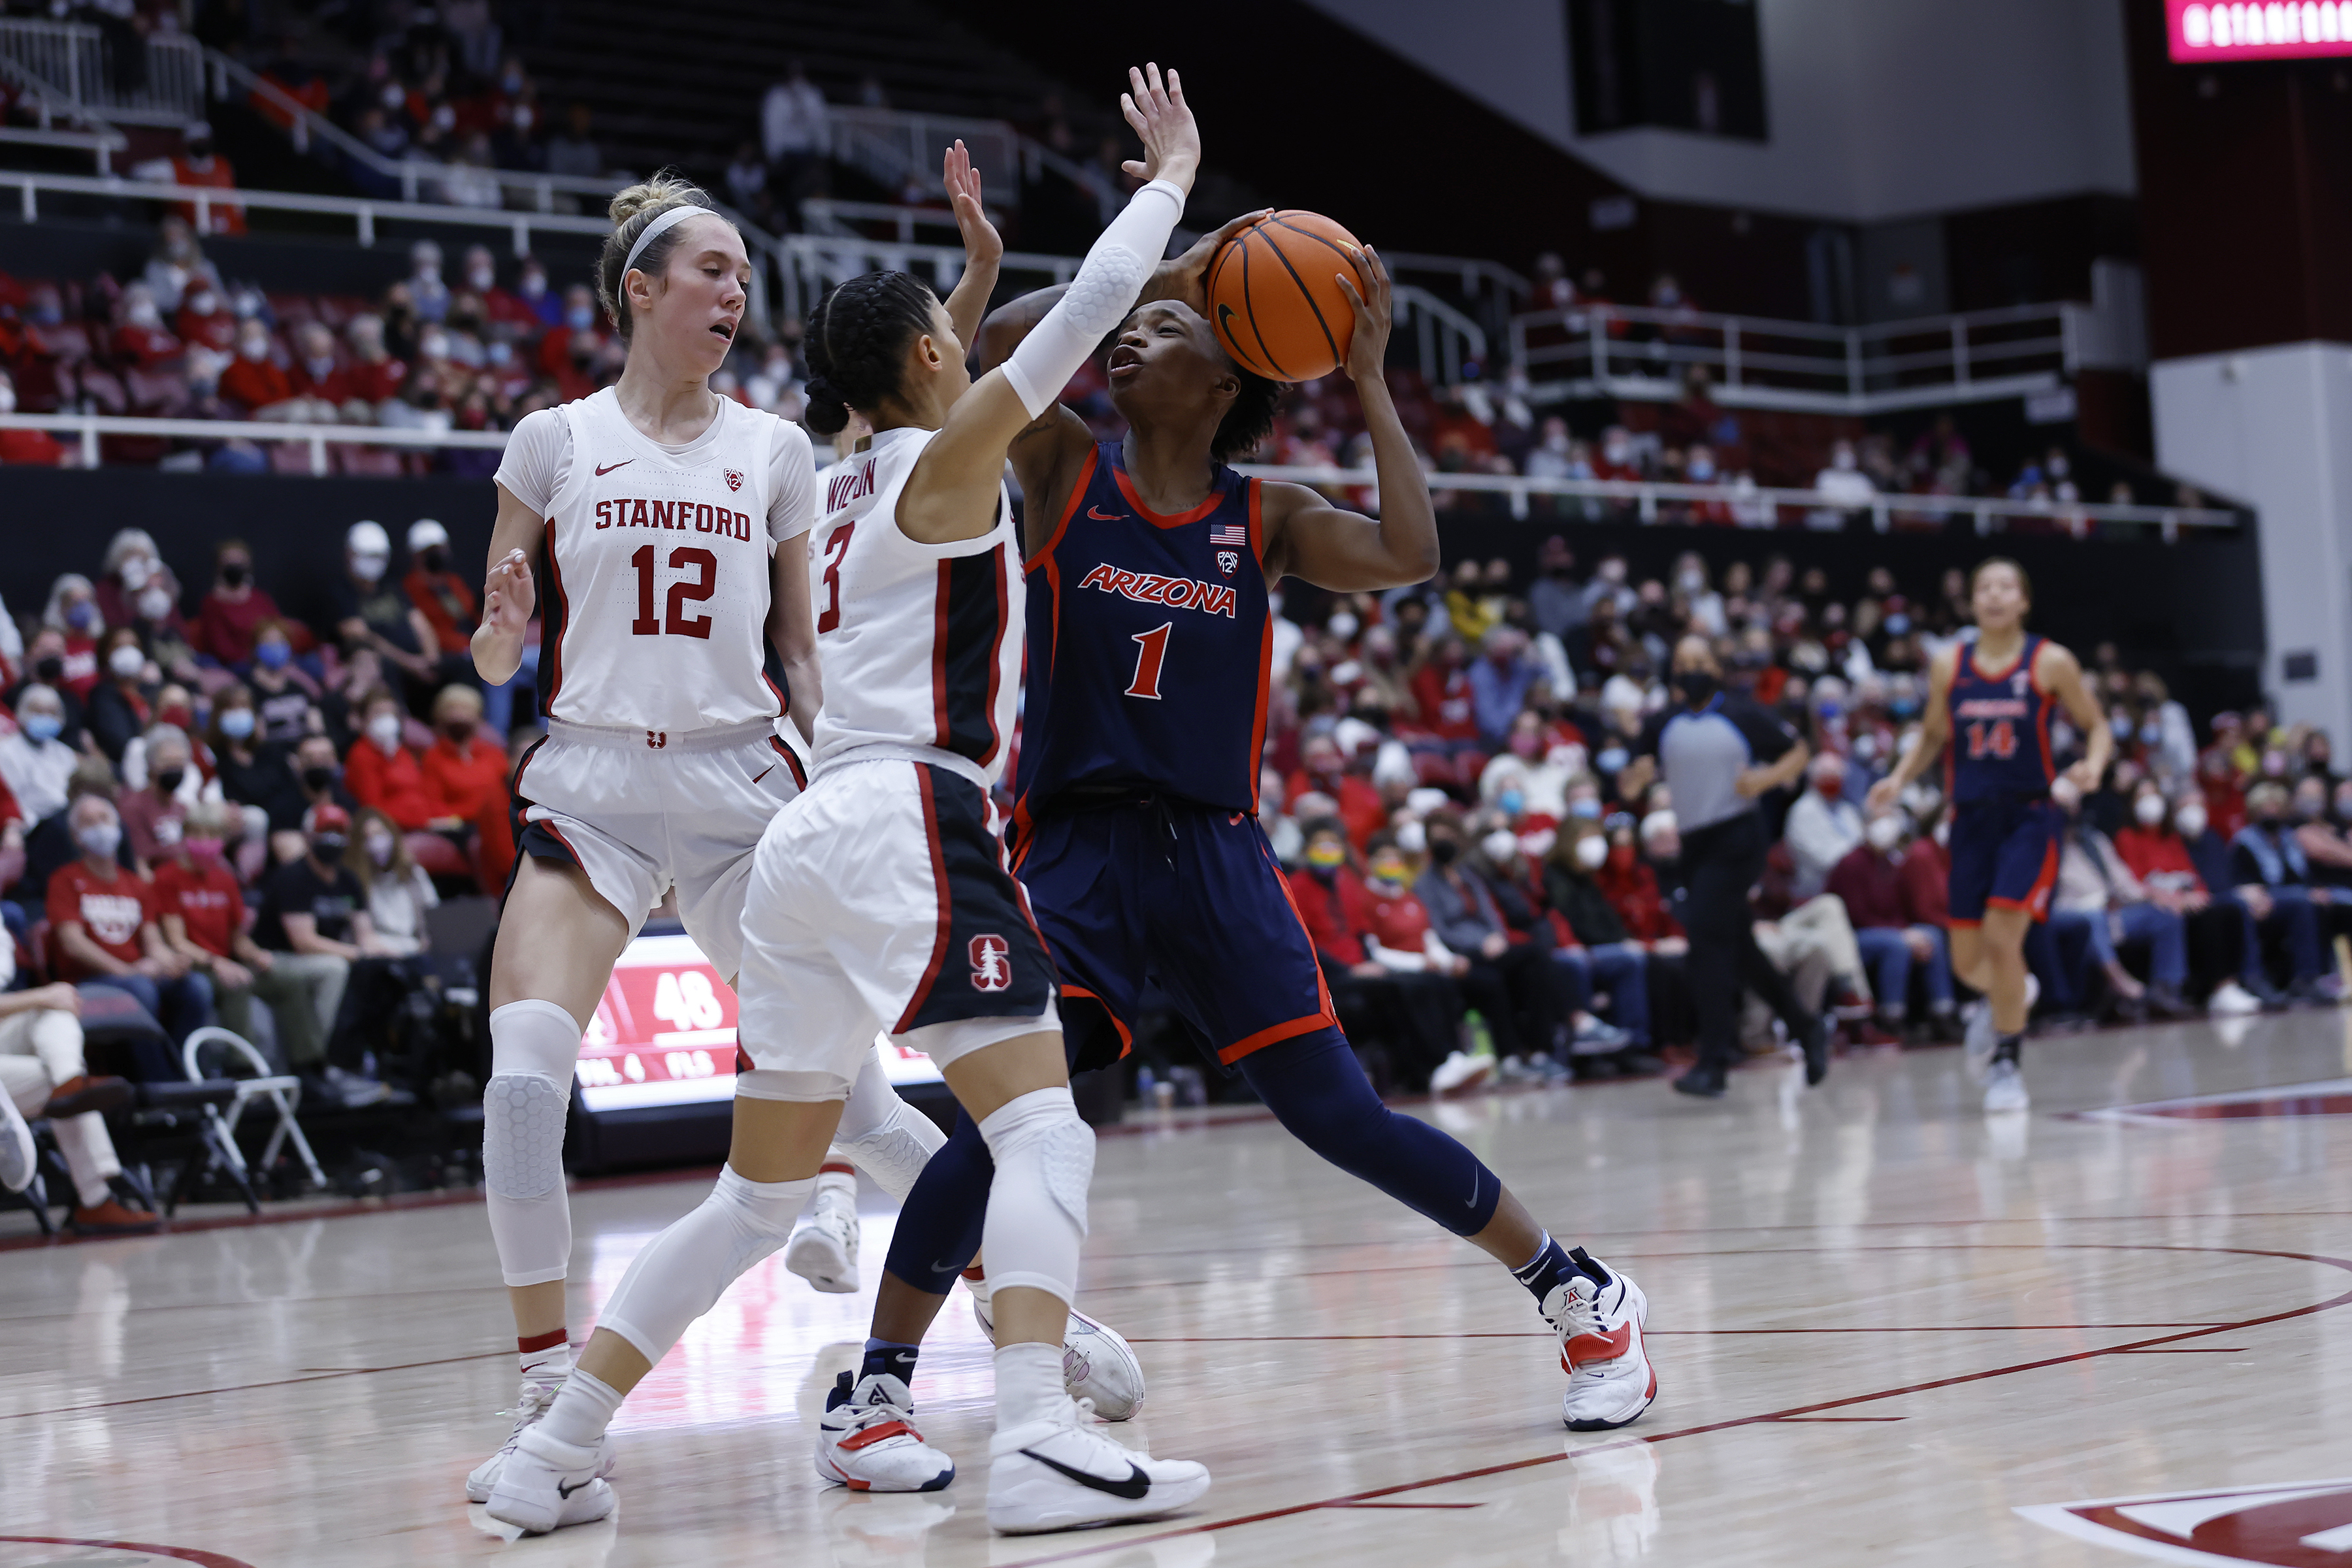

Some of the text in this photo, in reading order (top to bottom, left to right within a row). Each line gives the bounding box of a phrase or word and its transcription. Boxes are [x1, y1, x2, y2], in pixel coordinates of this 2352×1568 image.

[596, 498, 751, 543] STANFORD
[632, 545, 717, 640] 12
[817, 521, 855, 634] 3
[1078, 562, 1236, 619] ARIZONA
[1124, 621, 1173, 700] 1
[1967, 719, 2019, 760] 14
[653, 971, 723, 1032] 48
